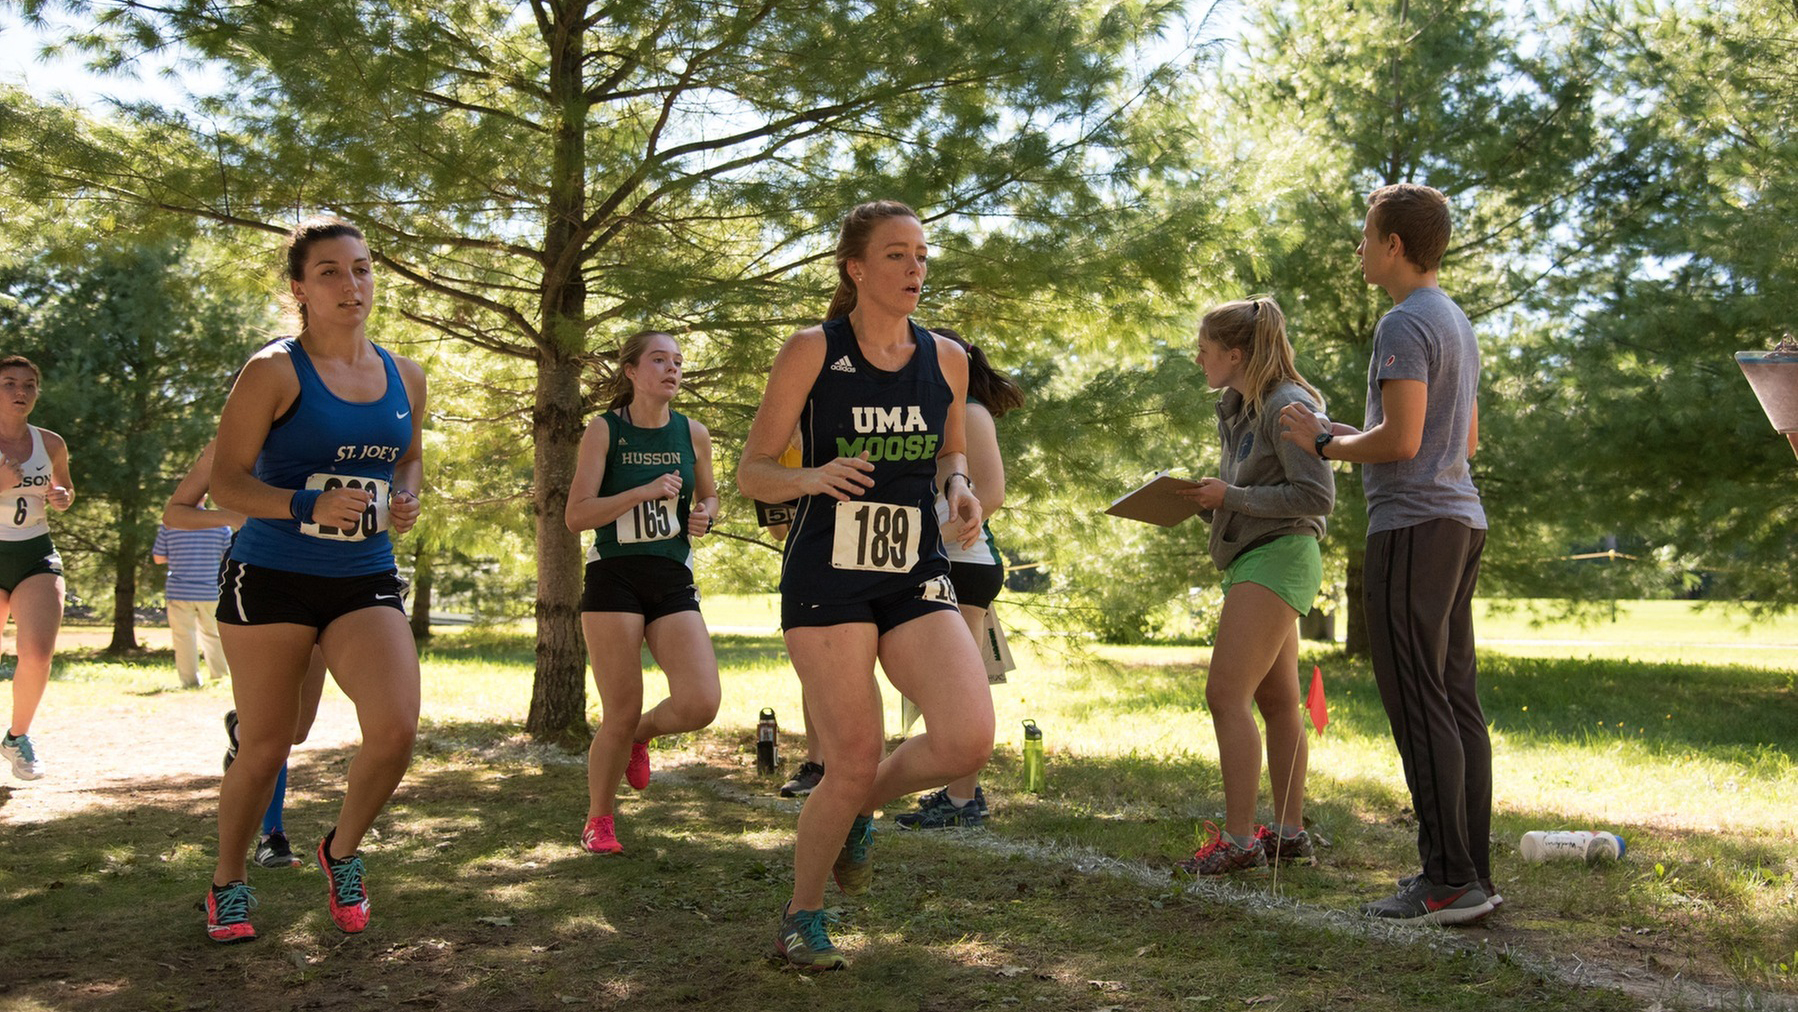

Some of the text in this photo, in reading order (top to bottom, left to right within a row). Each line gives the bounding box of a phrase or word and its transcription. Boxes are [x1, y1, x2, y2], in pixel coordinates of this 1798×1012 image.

[830, 364, 856, 374] adidas
[852, 405, 928, 434] UMA
[334, 445, 400, 462] ST. JOE'S
[622, 452, 681, 466] HUSSON
[836, 434, 938, 462] MOOSE
[13, 496, 28, 525] 6
[632, 495, 671, 539] 165
[855, 505, 909, 569] 189
